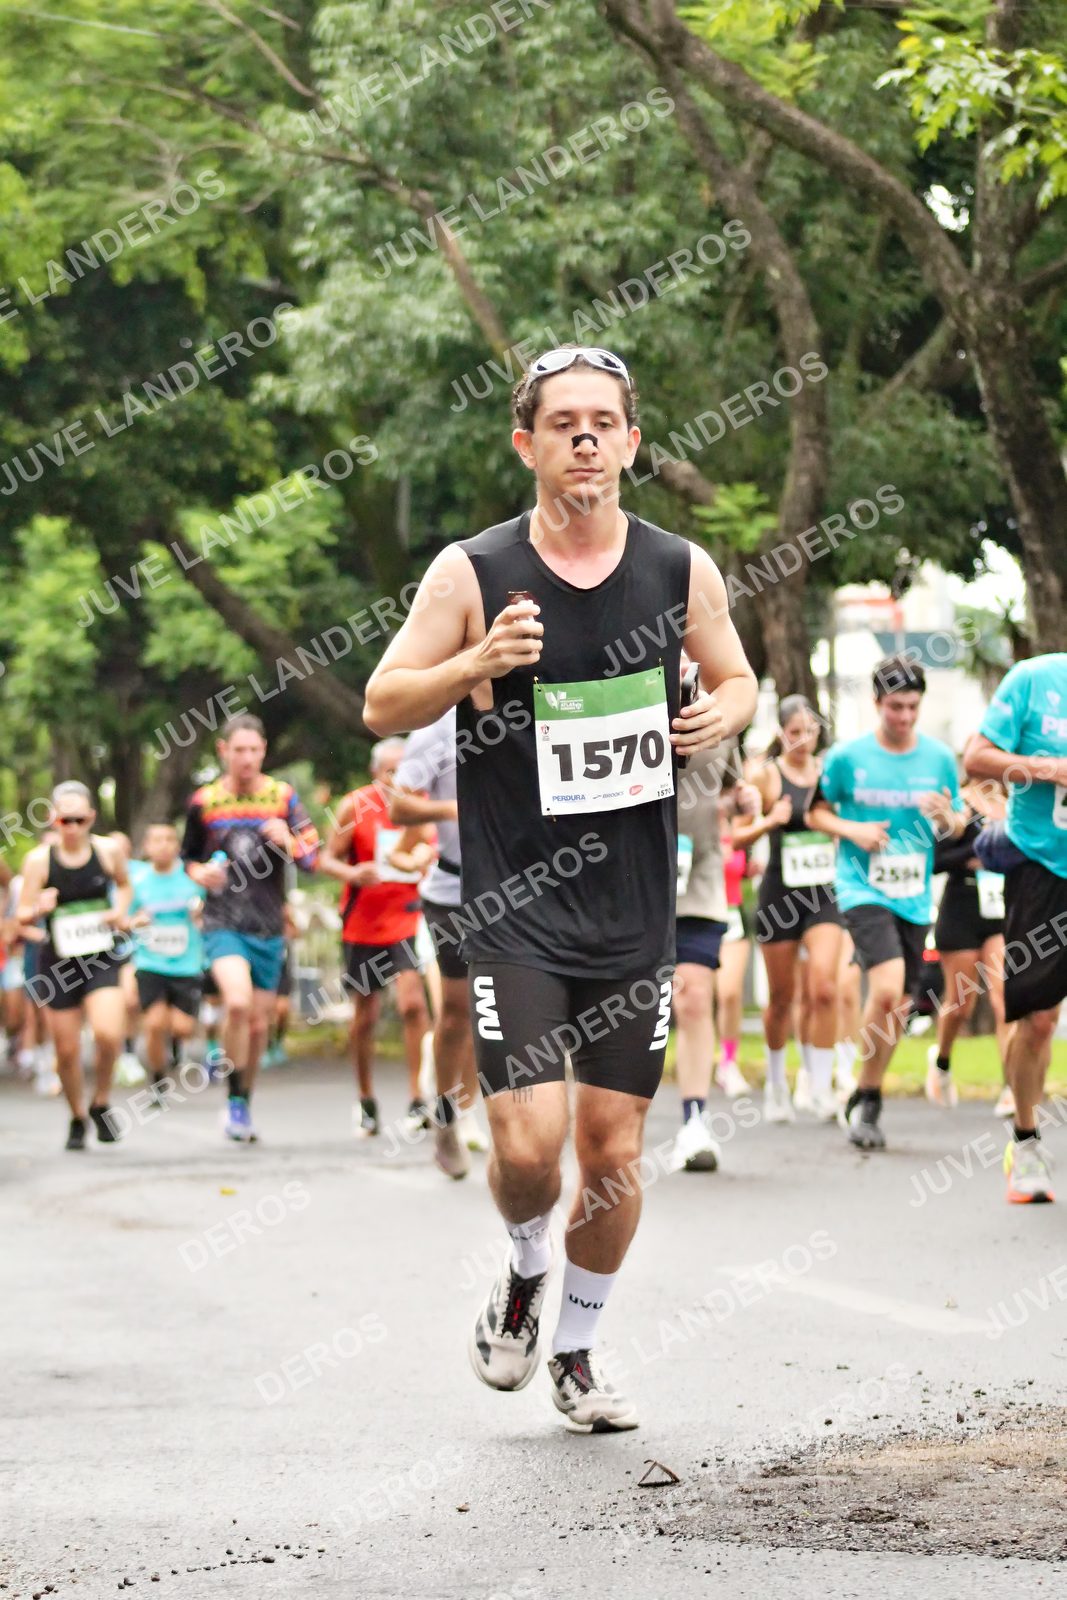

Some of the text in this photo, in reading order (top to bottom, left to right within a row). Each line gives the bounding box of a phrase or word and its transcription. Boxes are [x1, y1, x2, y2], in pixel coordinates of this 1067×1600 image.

[552, 730, 664, 781] 1570
[602, 791, 624, 799] BROOKS
[657, 788, 671, 797] 1570
[552, 794, 586, 803] PERDURA
